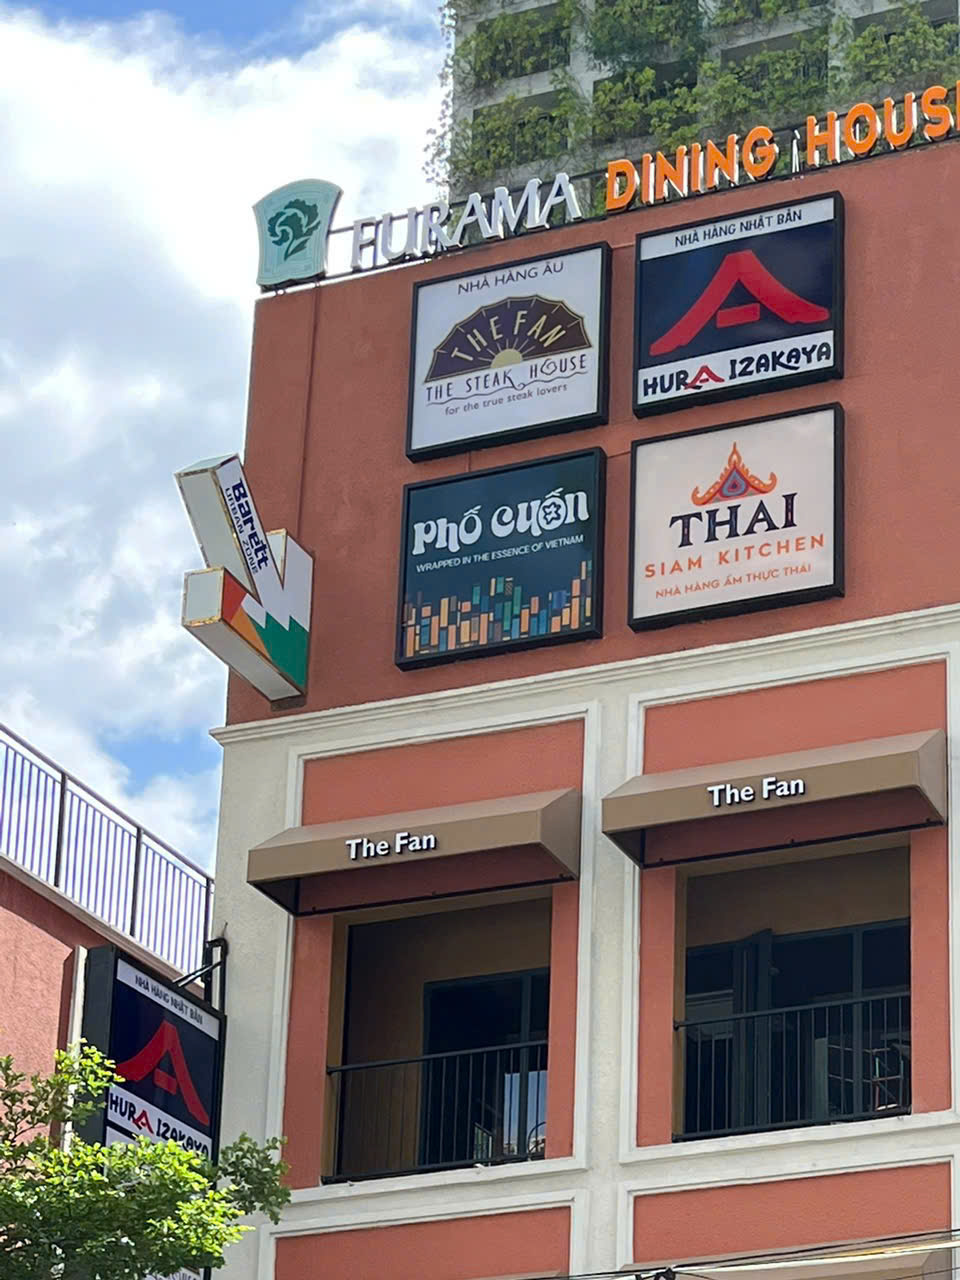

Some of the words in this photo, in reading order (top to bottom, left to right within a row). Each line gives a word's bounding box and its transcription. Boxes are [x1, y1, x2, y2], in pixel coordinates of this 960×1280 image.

[350, 172, 583, 271] FURAMA
[605, 125, 778, 214] DINING
[675, 229, 699, 247] NHÀ
[703, 222, 736, 241] HÀNG
[739, 214, 774, 232] NHẬT
[776, 209, 802, 225] BẢN
[457, 278, 491, 295] NHÀ
[494, 267, 539, 287] HÀNG
[451, 315, 503, 361] THE
[513, 310, 566, 348] FAN
[426, 382, 453, 401] THE
[466, 369, 517, 393] STEAK
[529, 354, 587, 379] HOUSE
[643, 365, 725, 396] HURA
[729, 342, 832, 380] IZAKAYA
[445, 406, 460, 416] for
[463, 401, 480, 413] the
[507, 390, 533, 403] steak
[536, 384, 567, 397] lovers
[668, 492, 798, 548] THAI
[416, 557, 461, 573] WRAPPED
[462, 555, 471, 565] IN
[473, 552, 490, 563] THE
[491, 544, 530, 560] ESSENCE
[531, 541, 544, 552] OF
[545, 534, 584, 550] VIETNAM
[644, 556, 703, 579] SIAM
[718, 533, 825, 566] KITCHEN
[655, 585, 681, 599] NHÀ
[684, 578, 720, 595] HÀNG
[707, 780, 755, 807] The
[761, 774, 805, 799] Fan
[345, 836, 389, 861] The
[393, 829, 436, 855] Fan
